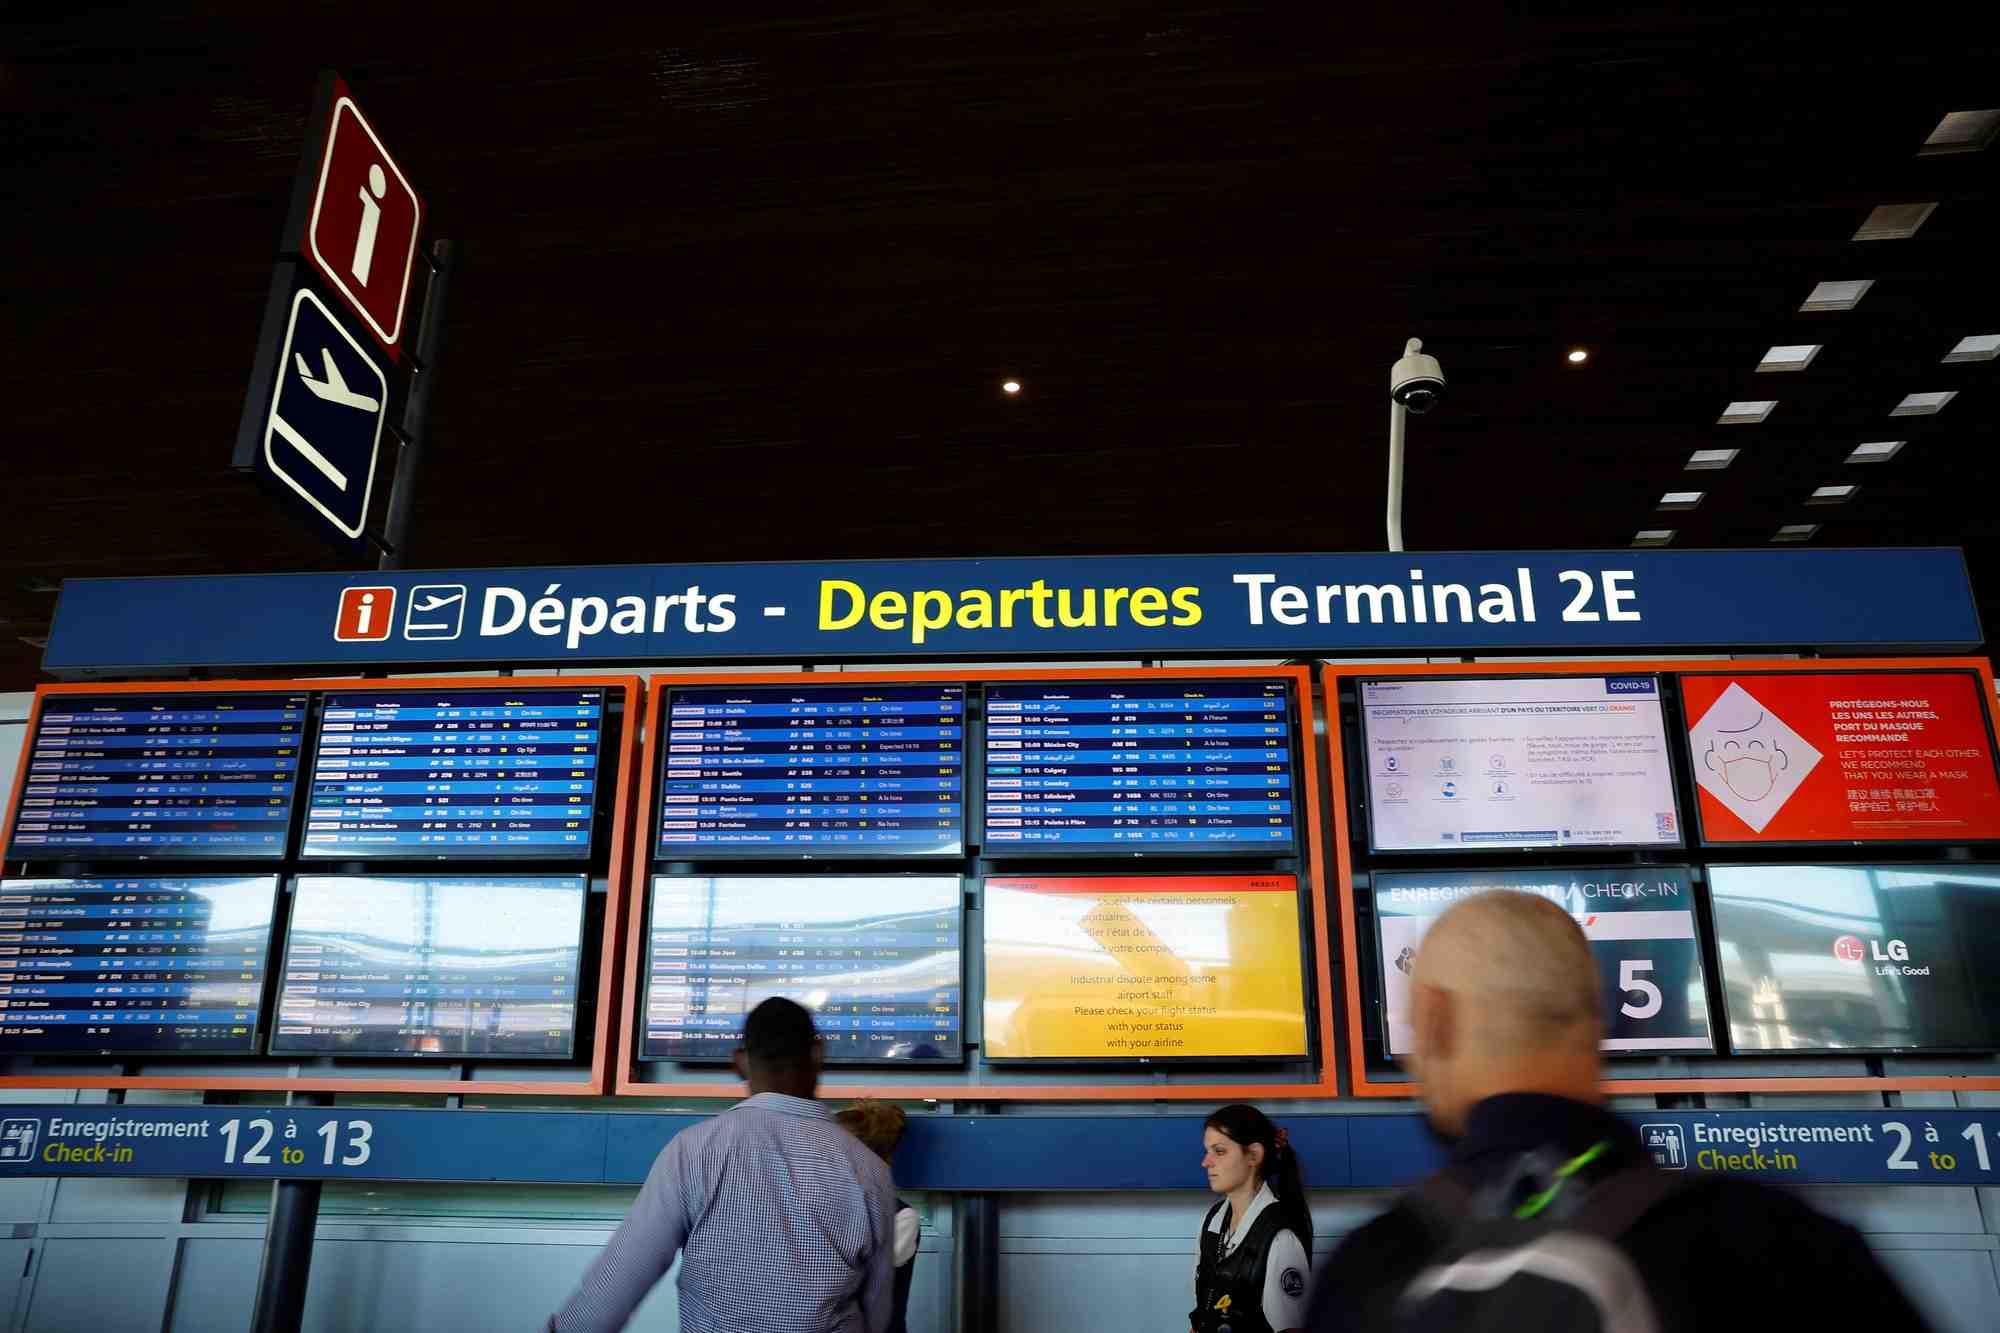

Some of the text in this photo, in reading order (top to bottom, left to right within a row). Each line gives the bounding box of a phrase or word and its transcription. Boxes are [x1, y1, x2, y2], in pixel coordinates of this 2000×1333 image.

[479, 583, 737, 649] Départs
[817, 579, 1203, 644] Departures
[1233, 567, 1535, 626] Terminal
[1558, 568, 1641, 623] 2E
[1610, 681, 1650, 690] COVID-19
[1829, 699, 1930, 709] PROTÉGEONS-NOUS
[1831, 712, 1851, 720] LES
[1852, 712, 1873, 720] UNS
[1875, 711, 1894, 719] LES
[1834, 722, 1925, 731] PORT DU MASQUE
[1835, 732, 1909, 742] RECOMMANDÉ
[1839, 750, 1866, 759] LET'S
[1868, 750, 1912, 758] PROTECT
[1915, 749, 1944, 758] EACH
[1841, 760, 1926, 769] WE RECOMMEND
[1843, 771, 1868, 780] THAT
[1871, 771, 1893, 780] YOU
[1895, 771, 1927, 780] WEAR
[1928, 771, 1937, 779] A
[1582, 881, 1680, 900] CHECK-IN
[1185, 896, 1238, 906] personnels
[1870, 939, 1910, 961] LG
[1902, 966, 1930, 976] Good
[1070, 975, 1217, 986] Industrial dispute among some
[1618, 959, 1663, 1020] 5
[1117, 990, 1150, 1001] airport
[1073, 1006, 1105, 1016] Please
[1106, 1006, 1135, 1016] check
[1136, 1008, 1159, 1017] your
[1187, 1006, 1217, 1015] status
[1107, 1021, 1184, 1034] with your status
[1106, 1037, 1185, 1049] with your airline
[48, 1117, 374, 1167] Enregistrement 12 à 13
[1693, 1120, 2000, 1171] Enregistrement 2 à 1
[43, 1142, 305, 1165] Check-in to
[1696, 1148, 1957, 1171] Check-in to
